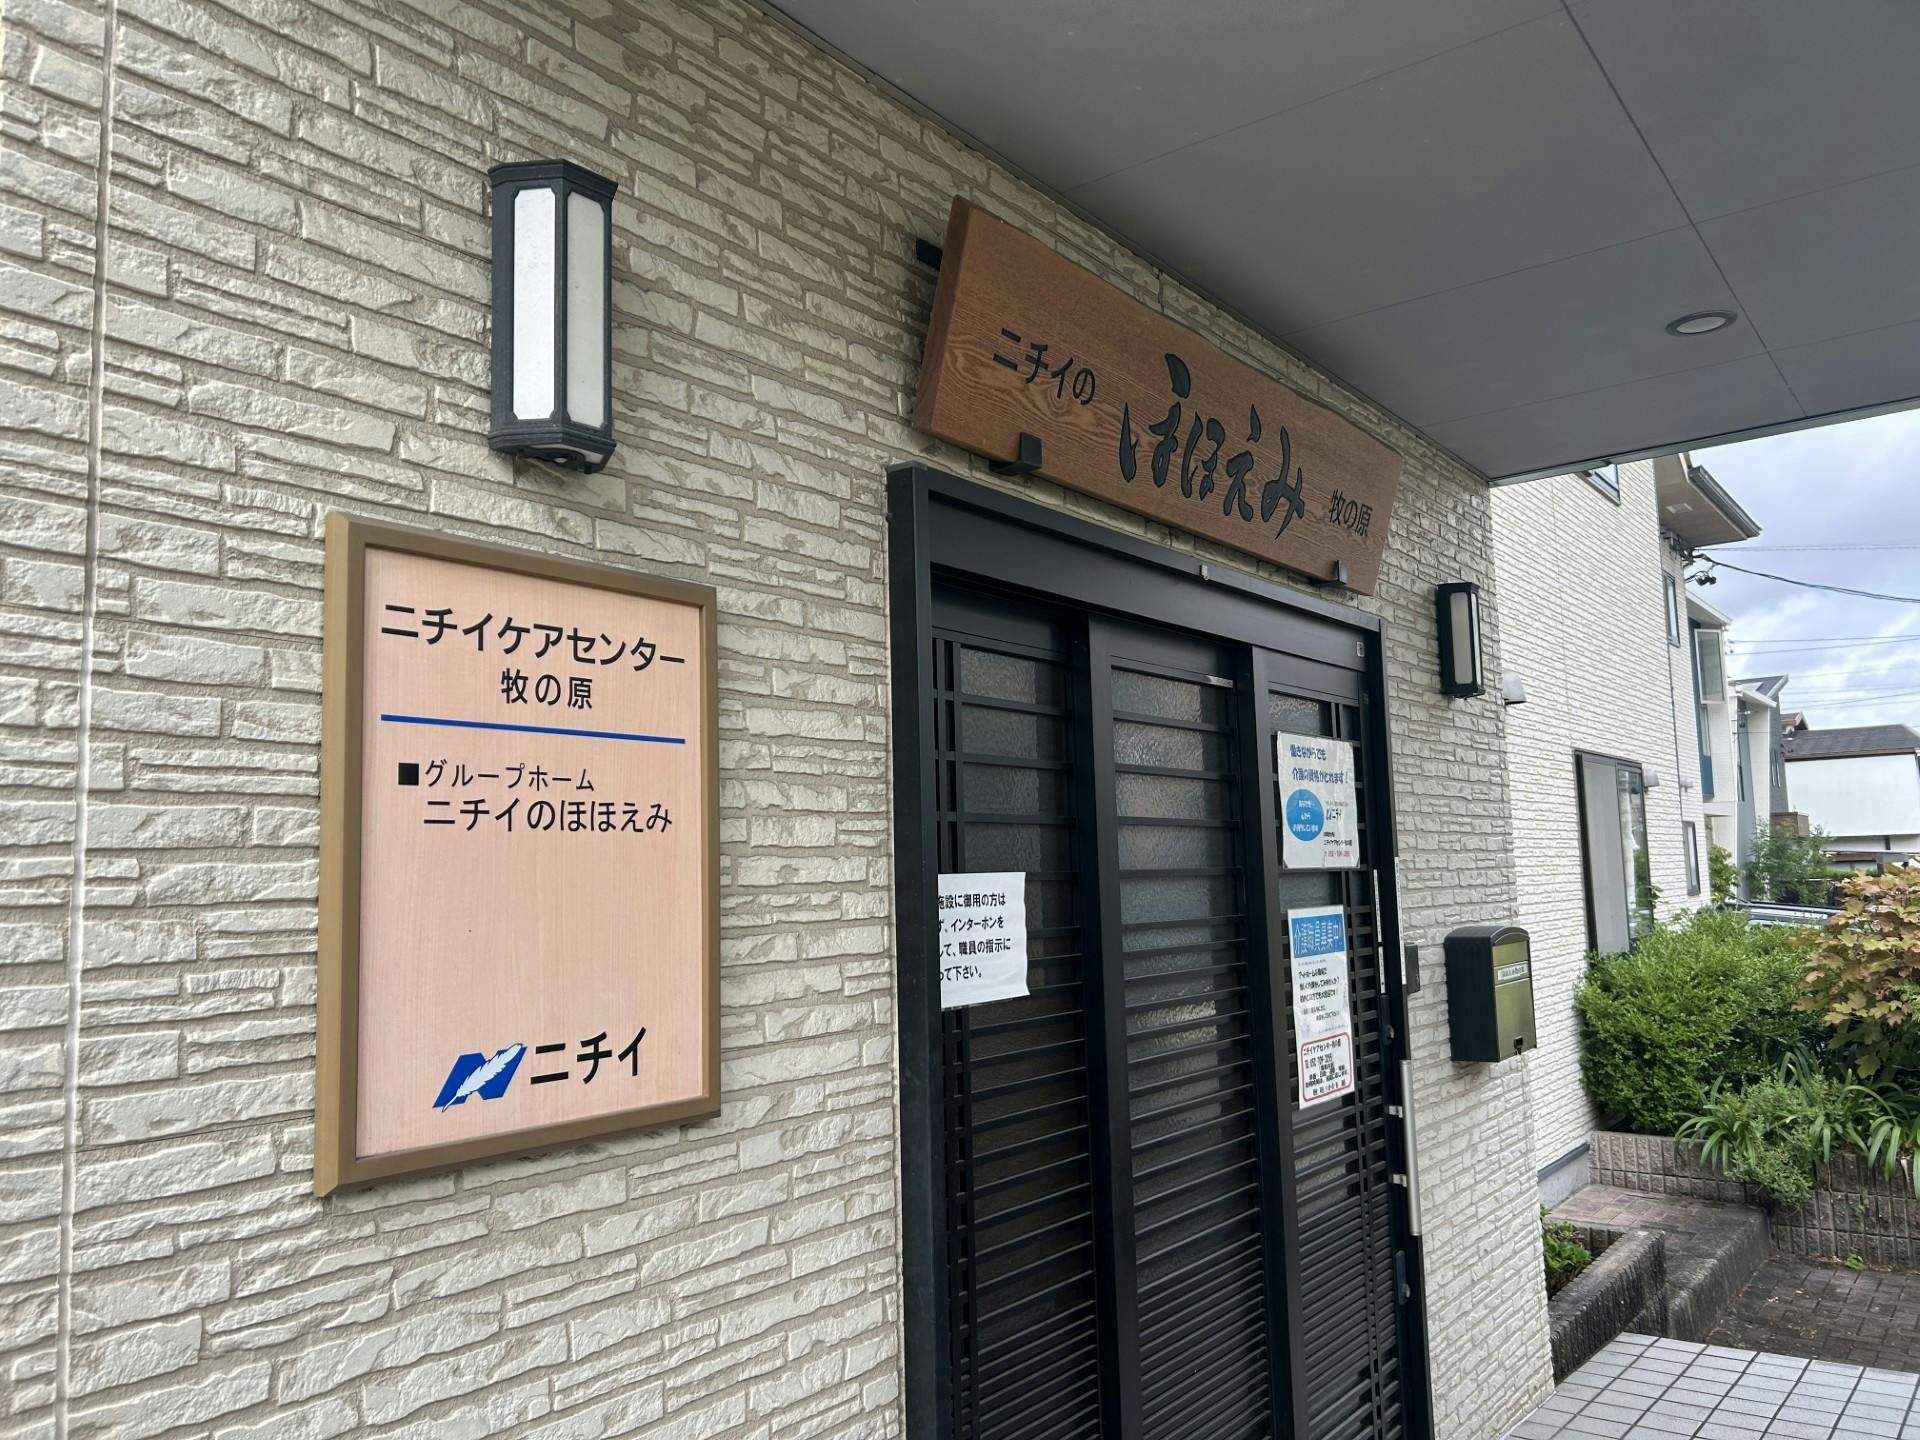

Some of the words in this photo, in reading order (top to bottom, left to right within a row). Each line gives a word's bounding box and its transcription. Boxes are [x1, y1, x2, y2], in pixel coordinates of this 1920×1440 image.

[993, 328, 1096, 405] ニチイの
[1119, 353, 1304, 540] ほほえみ
[1328, 489, 1372, 537] 牧の原
[381, 603, 685, 671] ニチイケアセンター
[501, 668, 592, 710] 牧の原
[424, 760, 595, 792] グループホーム
[424, 798, 672, 833] ニチイのほほえみ
[530, 1027, 646, 1085] ニチイ
